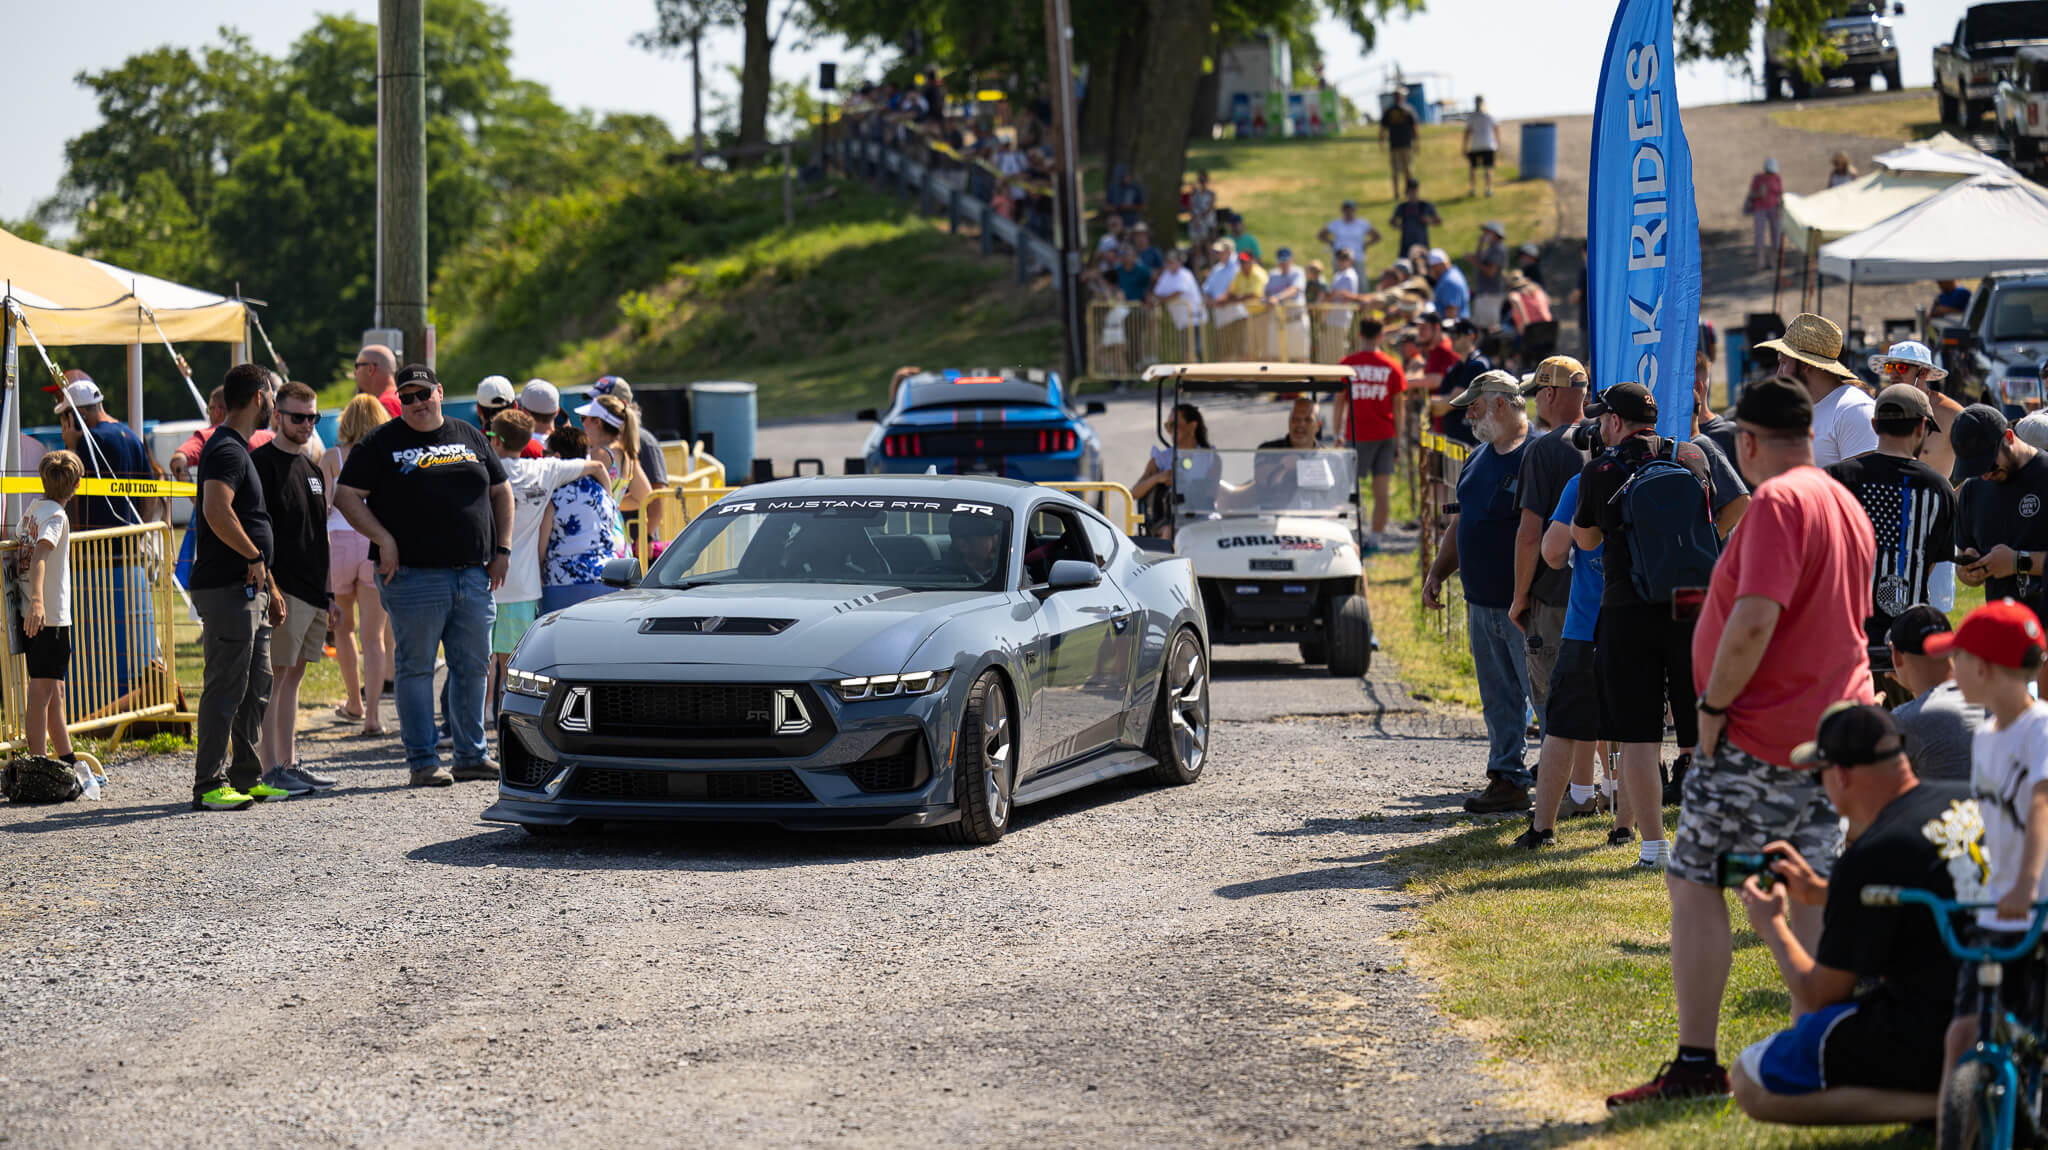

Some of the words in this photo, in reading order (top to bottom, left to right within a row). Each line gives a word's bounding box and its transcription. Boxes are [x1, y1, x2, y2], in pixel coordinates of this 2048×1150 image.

[1626, 42, 1667, 271] RIDES
[110, 482, 158, 493] CAUTION
[767, 500, 885, 509] MUSTANG
[891, 501, 941, 510] RTR
[1217, 535, 1321, 549] CARLISLE
